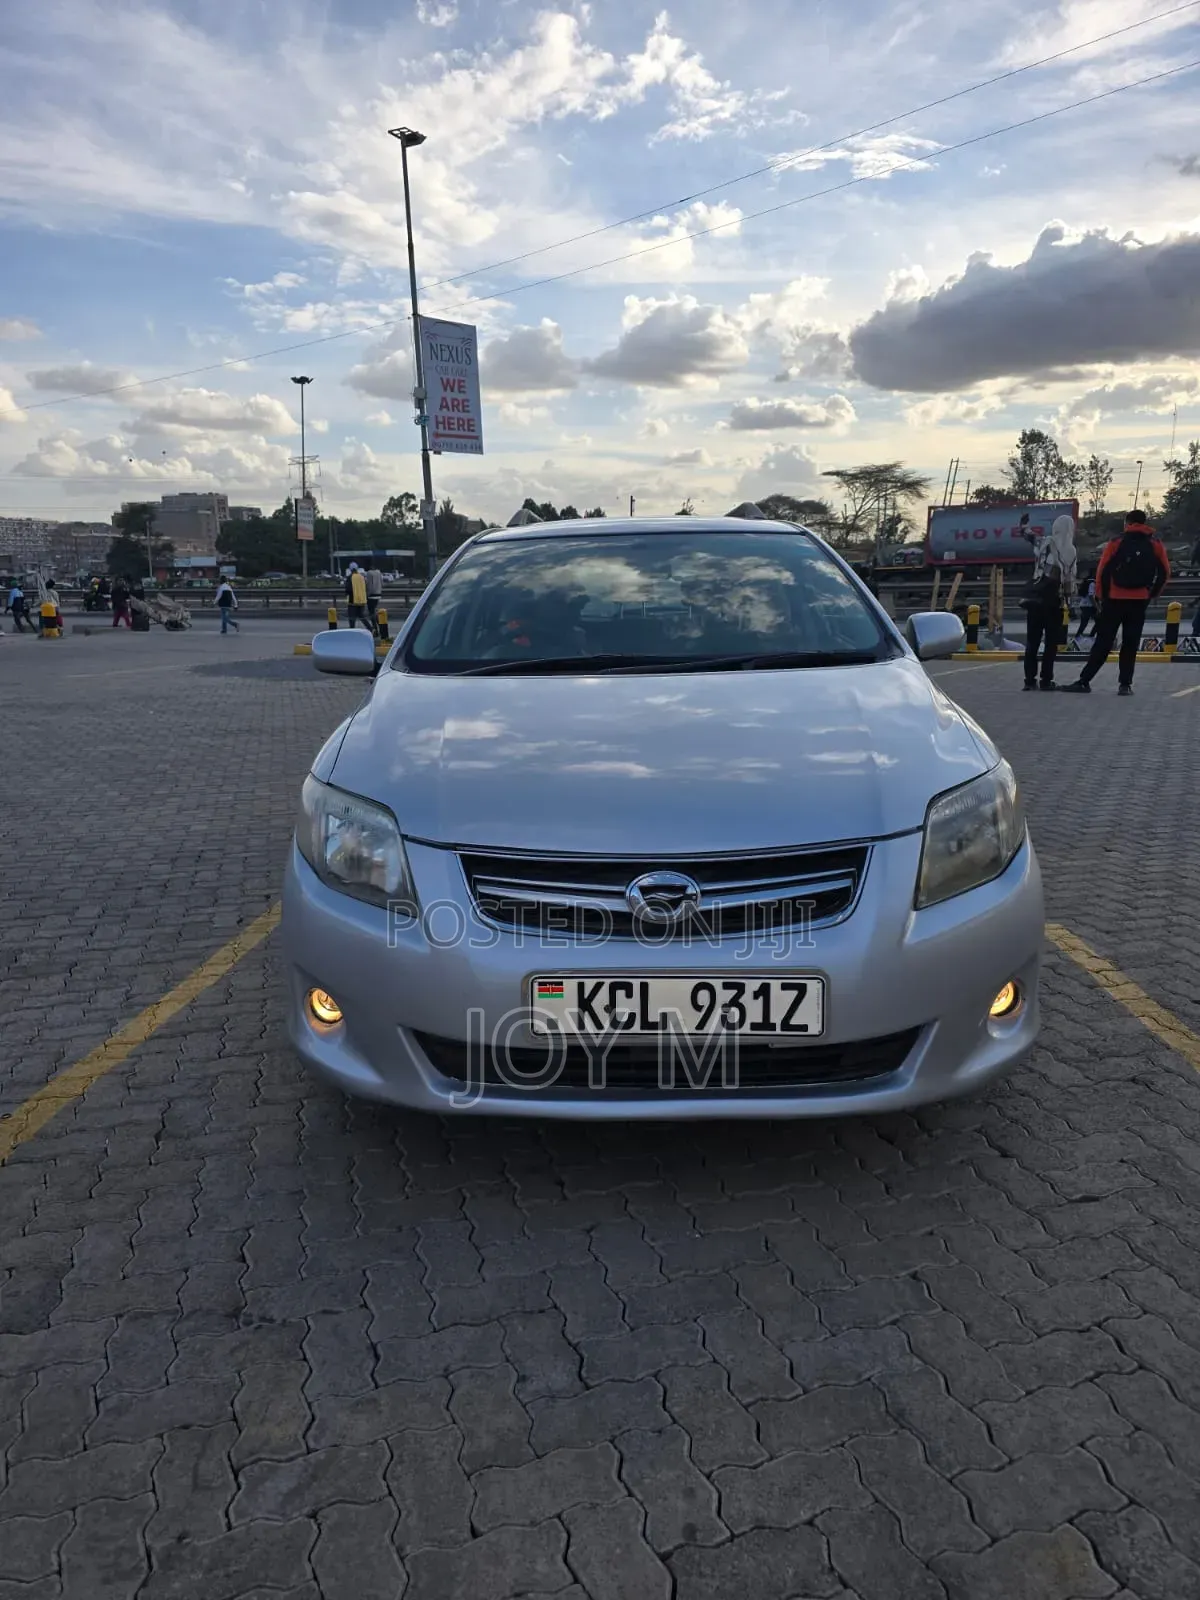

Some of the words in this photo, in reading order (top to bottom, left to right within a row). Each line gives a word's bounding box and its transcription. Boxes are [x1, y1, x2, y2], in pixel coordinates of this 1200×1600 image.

[429, 342, 472, 366] NEXUS
[440, 377, 467, 393] WE
[439, 397, 471, 413] ARE
[435, 415, 476, 432] HERE
[954, 526, 1046, 540] HOYER
[576, 981, 668, 1031] KCL
[690, 981, 809, 1032] 931Z
